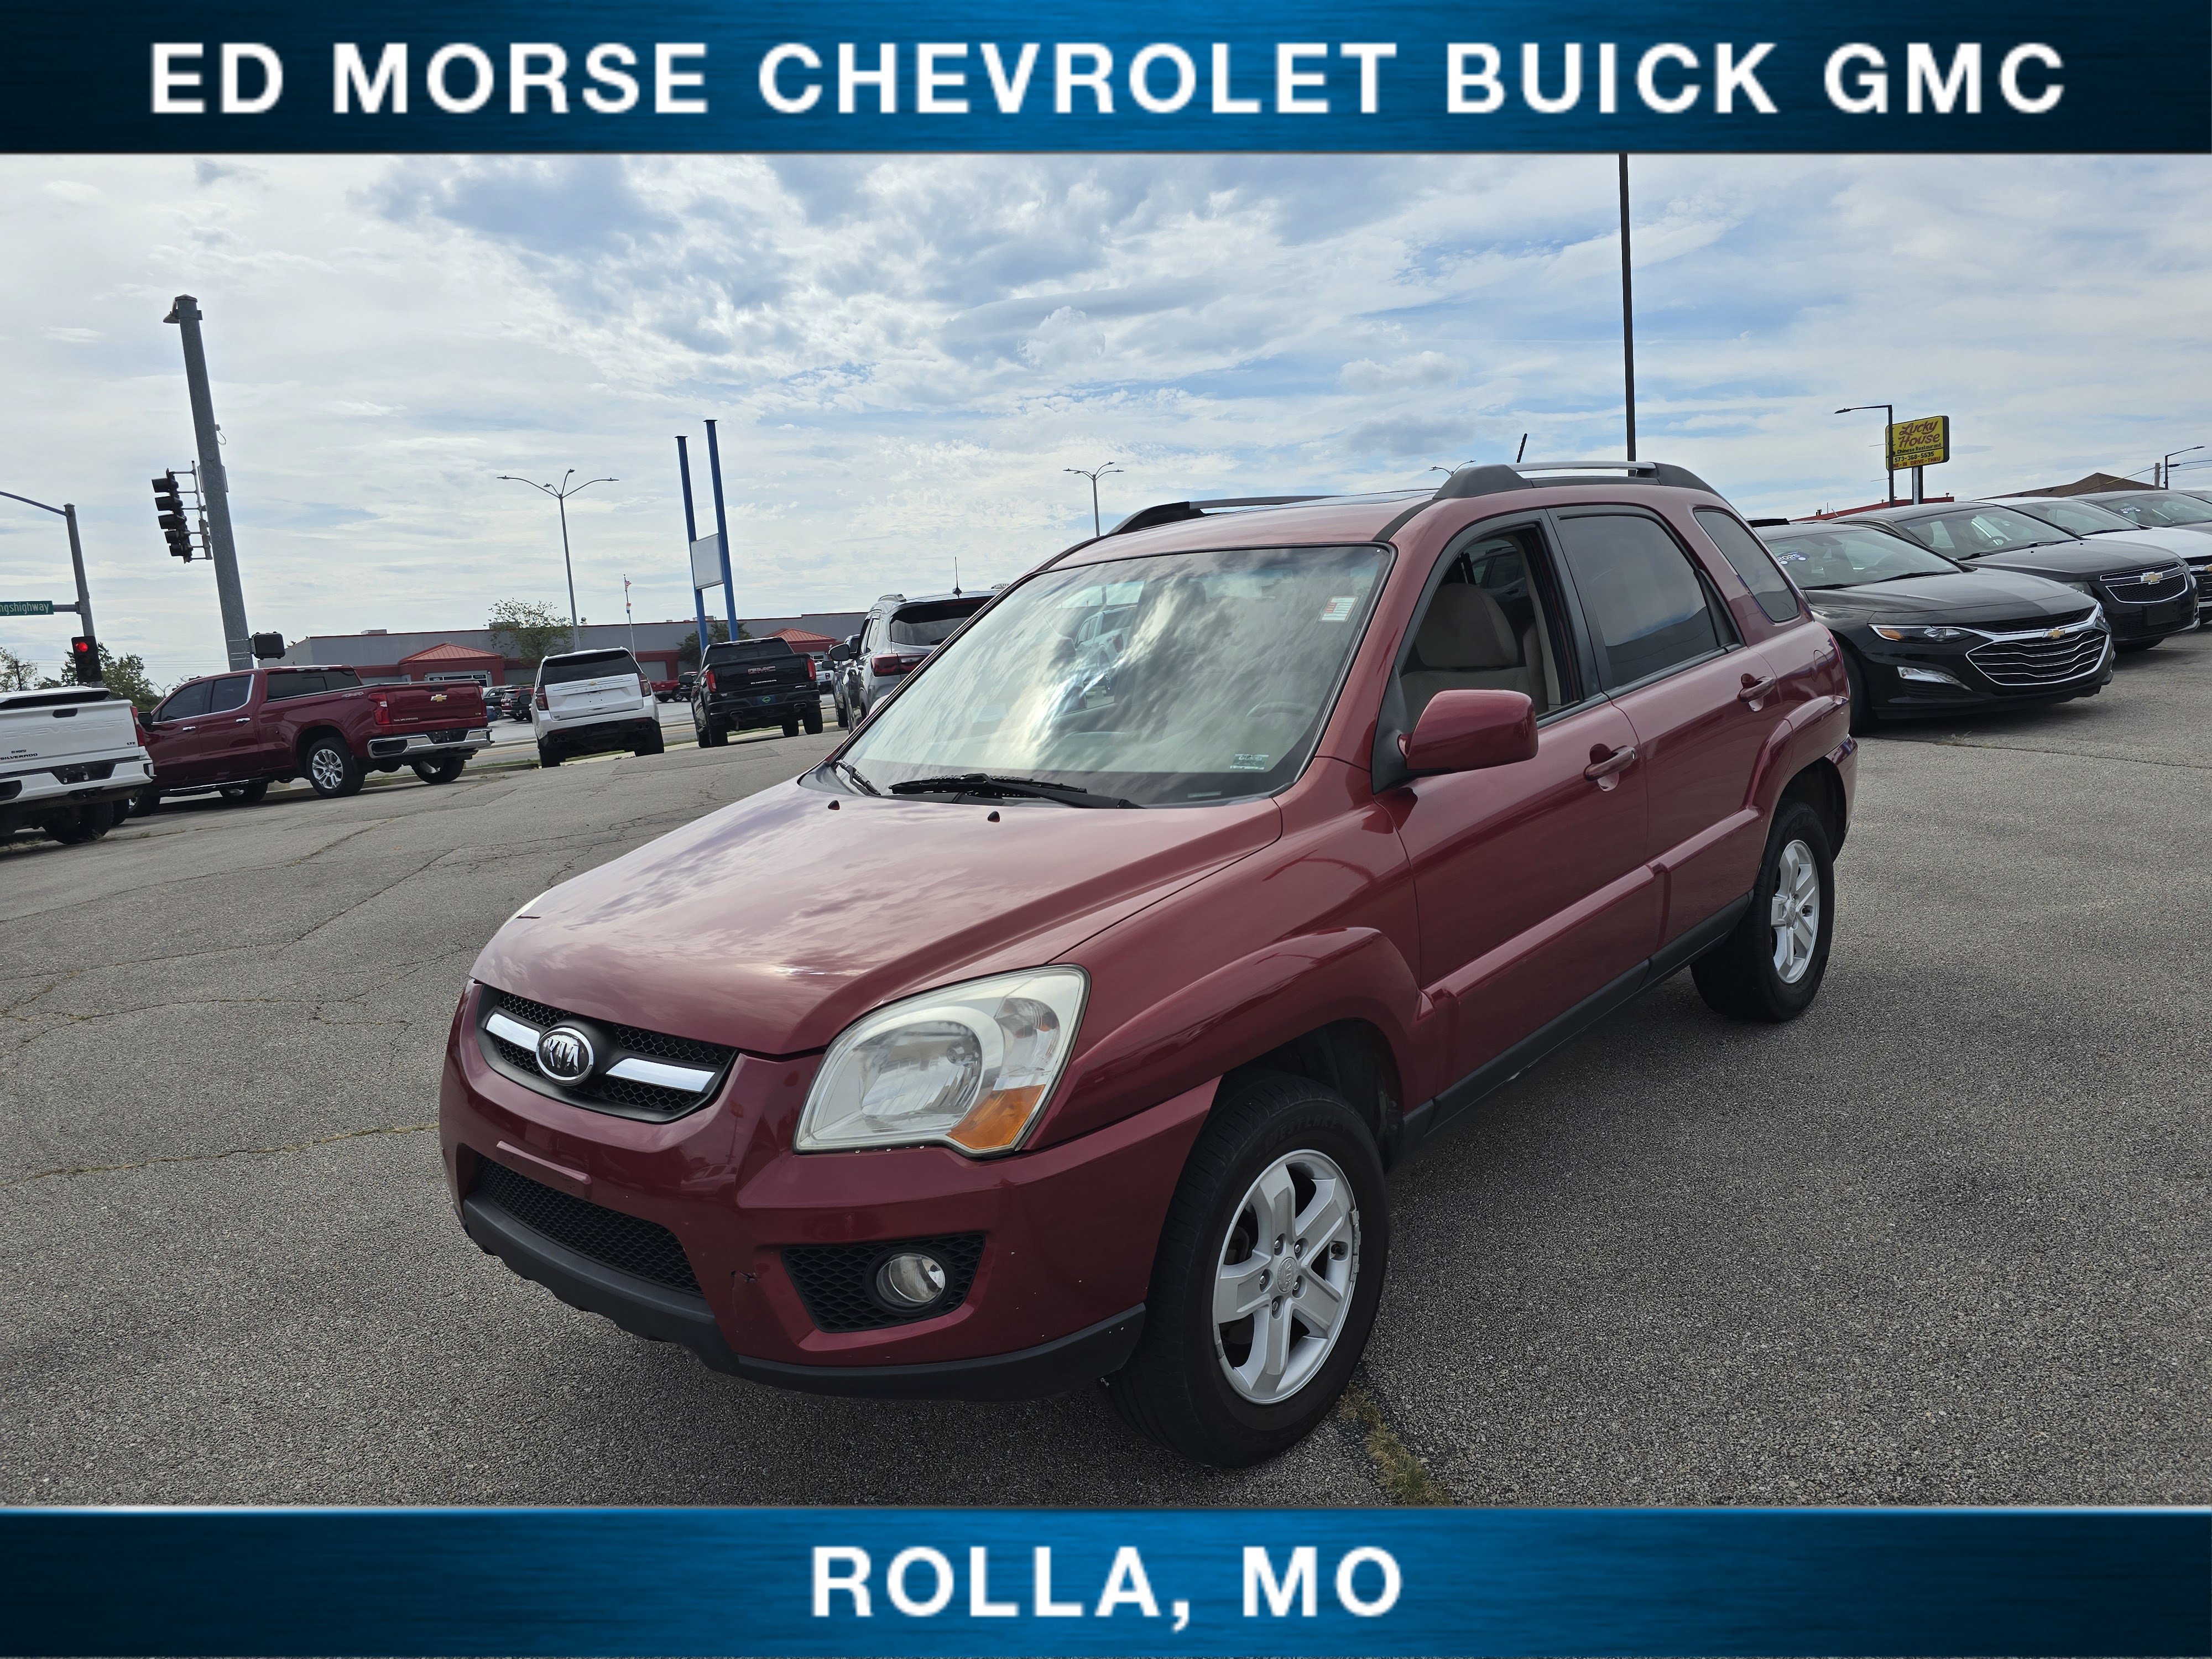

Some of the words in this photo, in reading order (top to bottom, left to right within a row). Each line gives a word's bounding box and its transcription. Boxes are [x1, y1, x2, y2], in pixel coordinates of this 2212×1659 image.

[1899, 420, 1938, 435] Lucky
[1898, 433, 1940, 448] House
[1916, 442, 1941, 451] Restaurant
[1911, 456, 1941, 465] DRIVE-THRU
[748, 666, 776, 675] GMC
[546, 1037, 579, 1074] KIA
